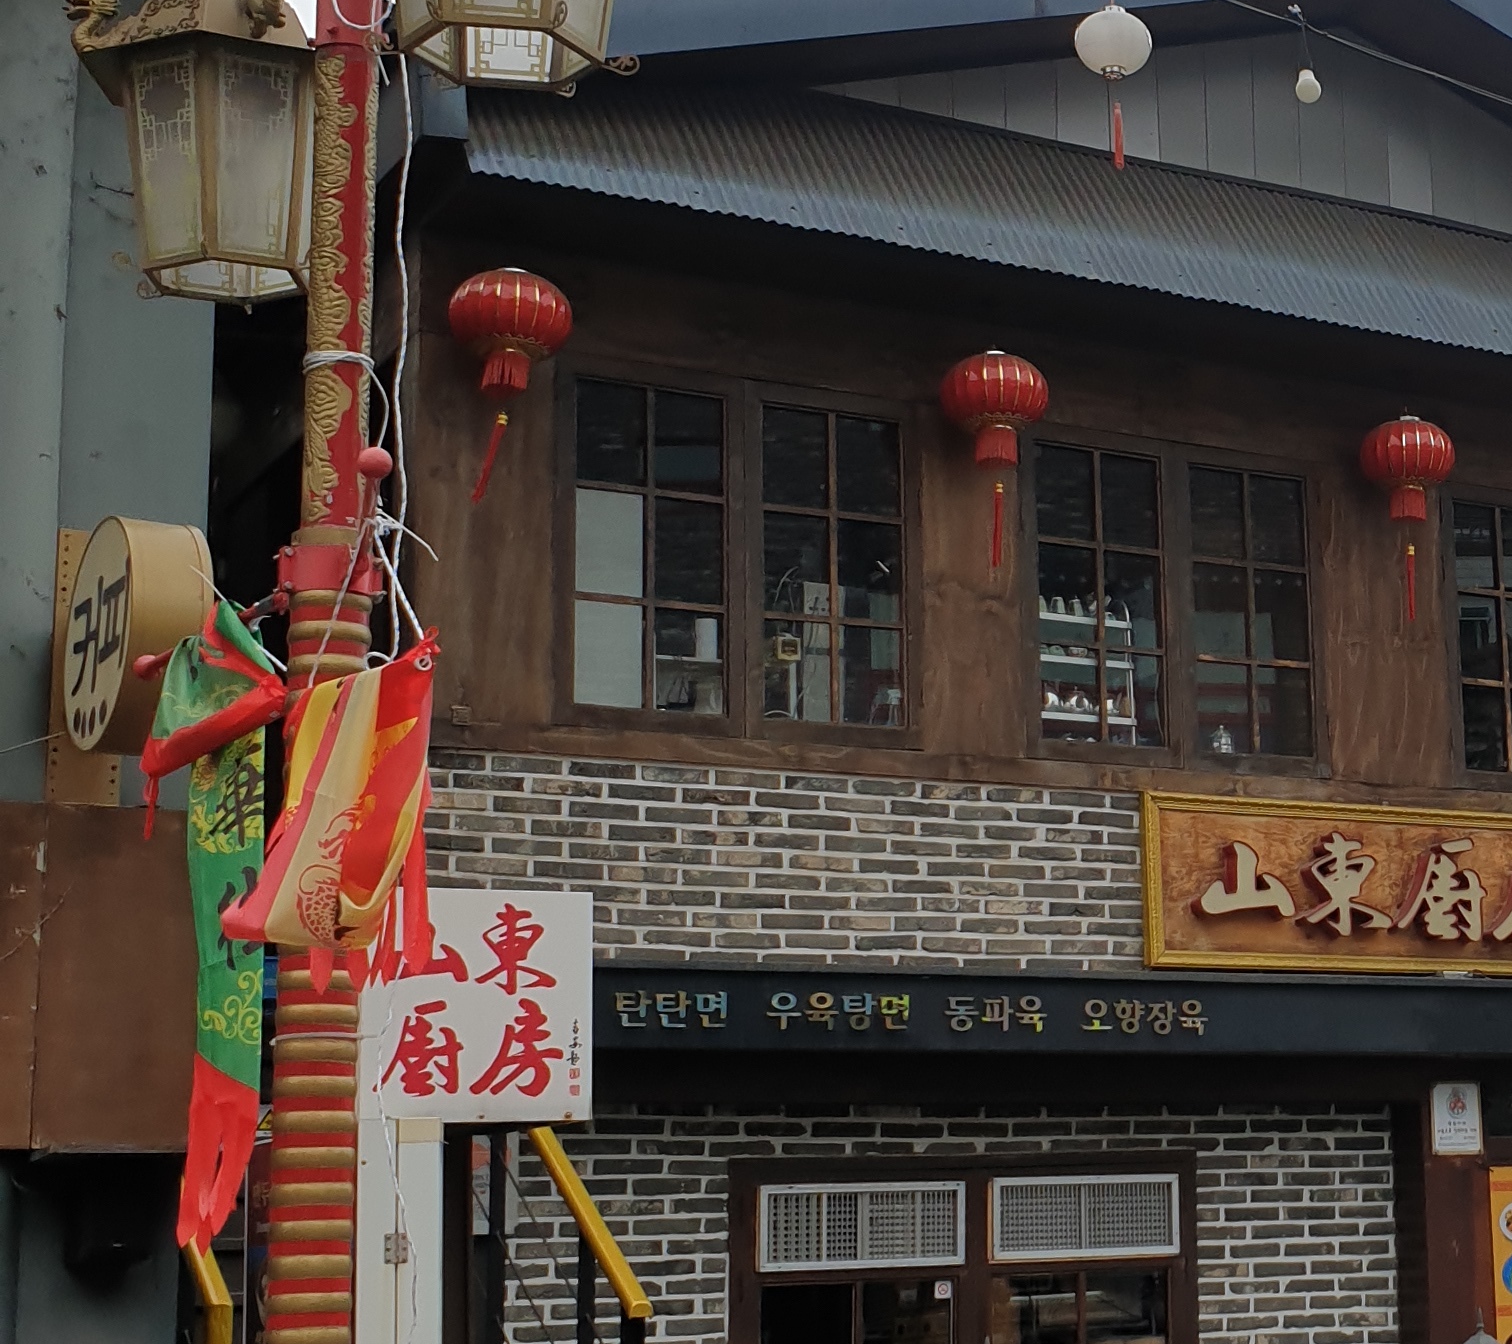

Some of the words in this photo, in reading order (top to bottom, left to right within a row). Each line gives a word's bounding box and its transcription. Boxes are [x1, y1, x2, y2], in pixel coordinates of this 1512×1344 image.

[73, 557, 131, 698] 커피
[615, 990, 730, 1029] 탄탄면
[766, 990, 911, 1031] 우육탕면
[944, 995, 1049, 1034] 동파육
[1081, 998, 1209, 1037] 오향장육
